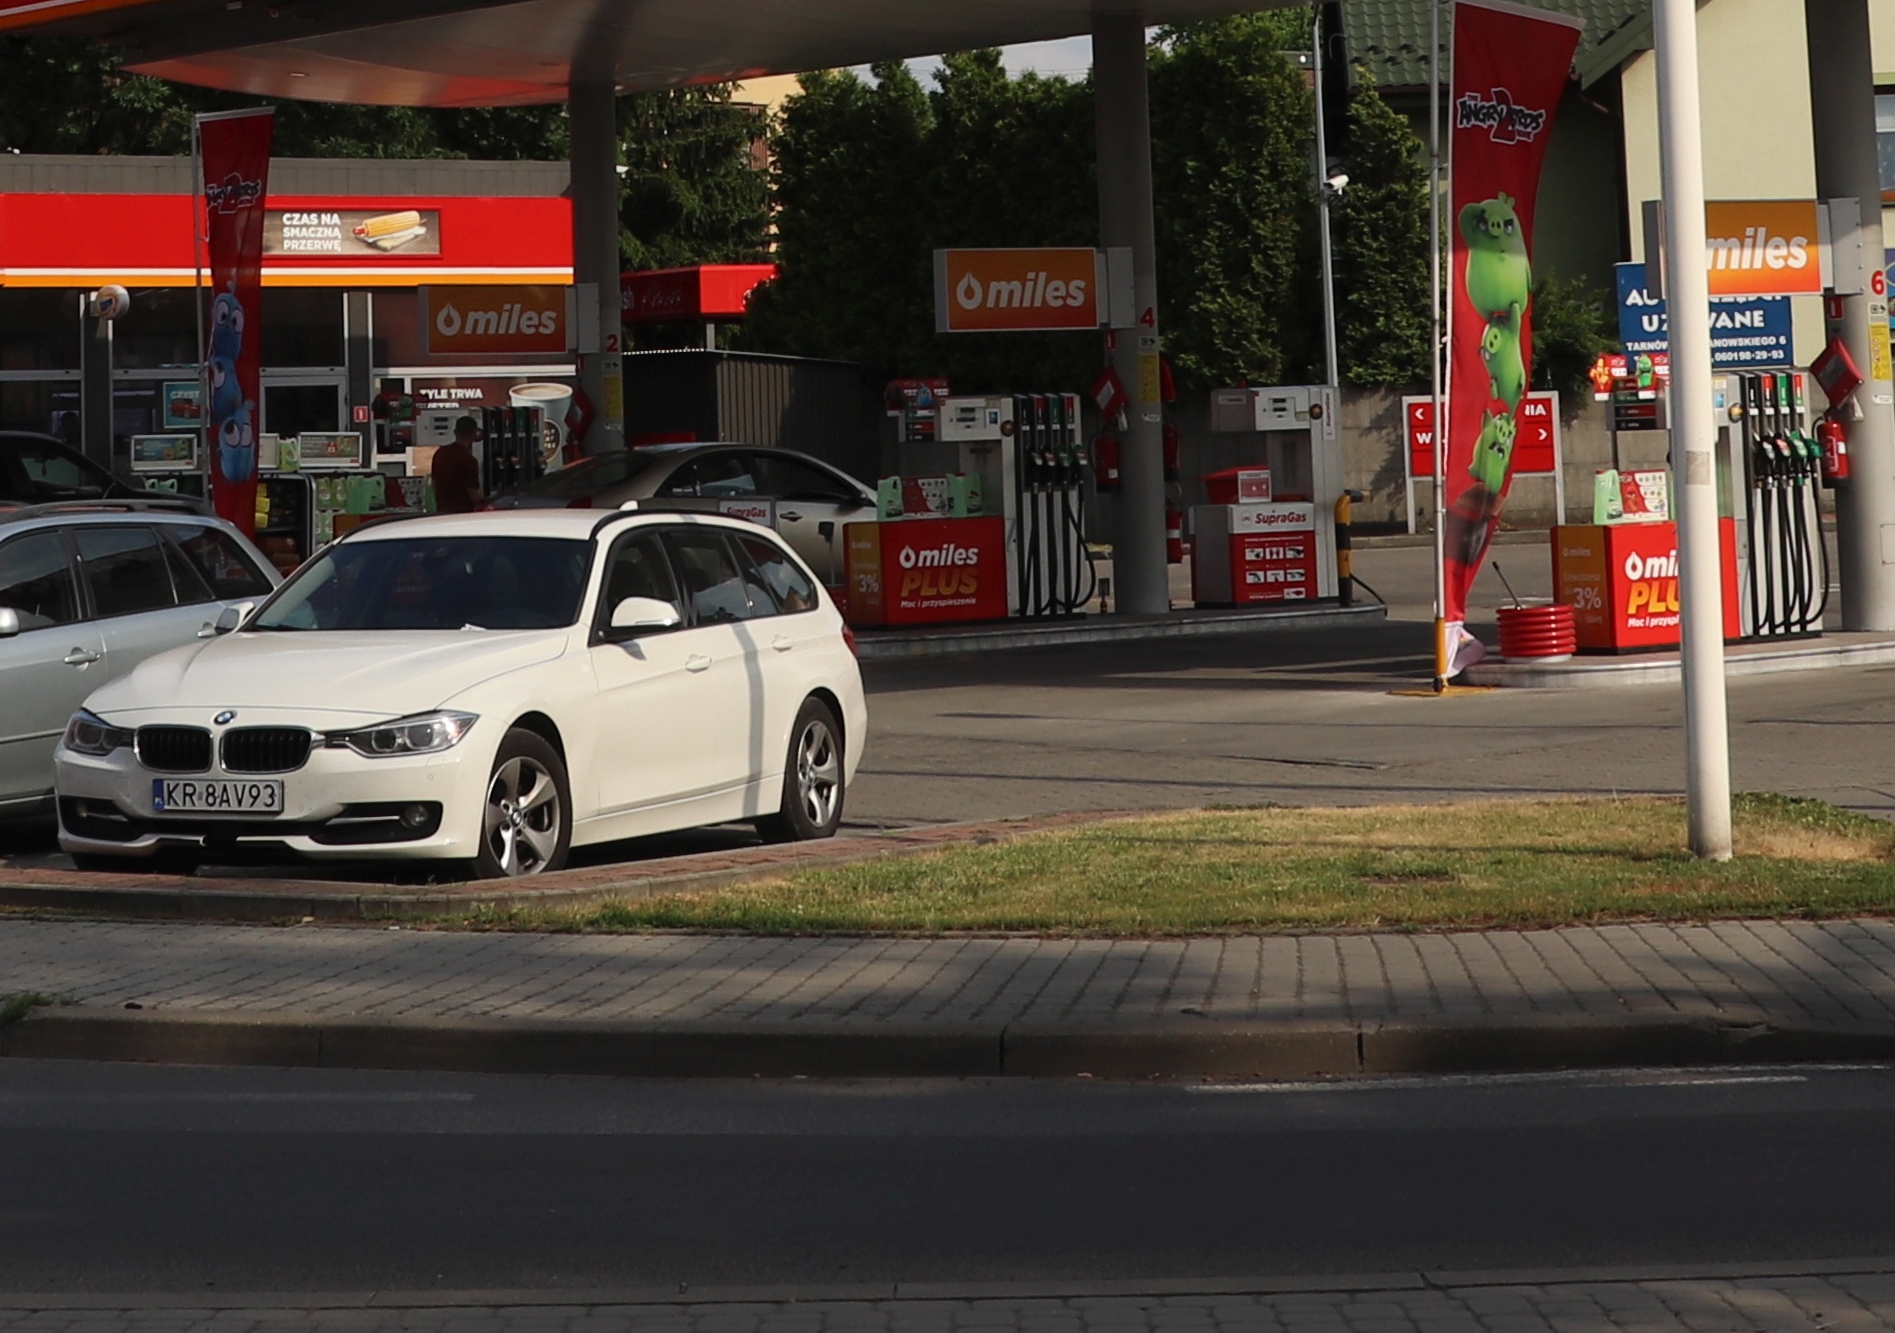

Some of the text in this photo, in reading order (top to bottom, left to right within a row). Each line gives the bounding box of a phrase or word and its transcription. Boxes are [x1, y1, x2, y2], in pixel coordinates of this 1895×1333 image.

[282, 213, 341, 225] CZAS NA
[283, 227, 342, 239] SMACZNĄ
[283, 239, 342, 252] PRZERWĘ
[1706, 227, 1808, 270] miles
[986, 271, 1087, 308] miles
[1871, 270, 1885, 296] 6
[464, 303, 557, 335] miles
[1140, 307, 1155, 328] 4
[607, 334, 619, 353] 2
[1779, 336, 1787, 345] 6
[449, 388, 483, 399] TRWA
[1254, 511, 1307, 527] SupraGas
[918, 543, 979, 567] miles
[858, 573, 879, 593] 3%
[900, 567, 979, 597] PLUS
[900, 599, 916, 609] Moc
[922, 596, 977, 609] przyspieszenie
[1573, 586, 1602, 611] 3%
[1627, 617, 1645, 628] Moc
[166, 782, 276, 808] KR 8AV93
